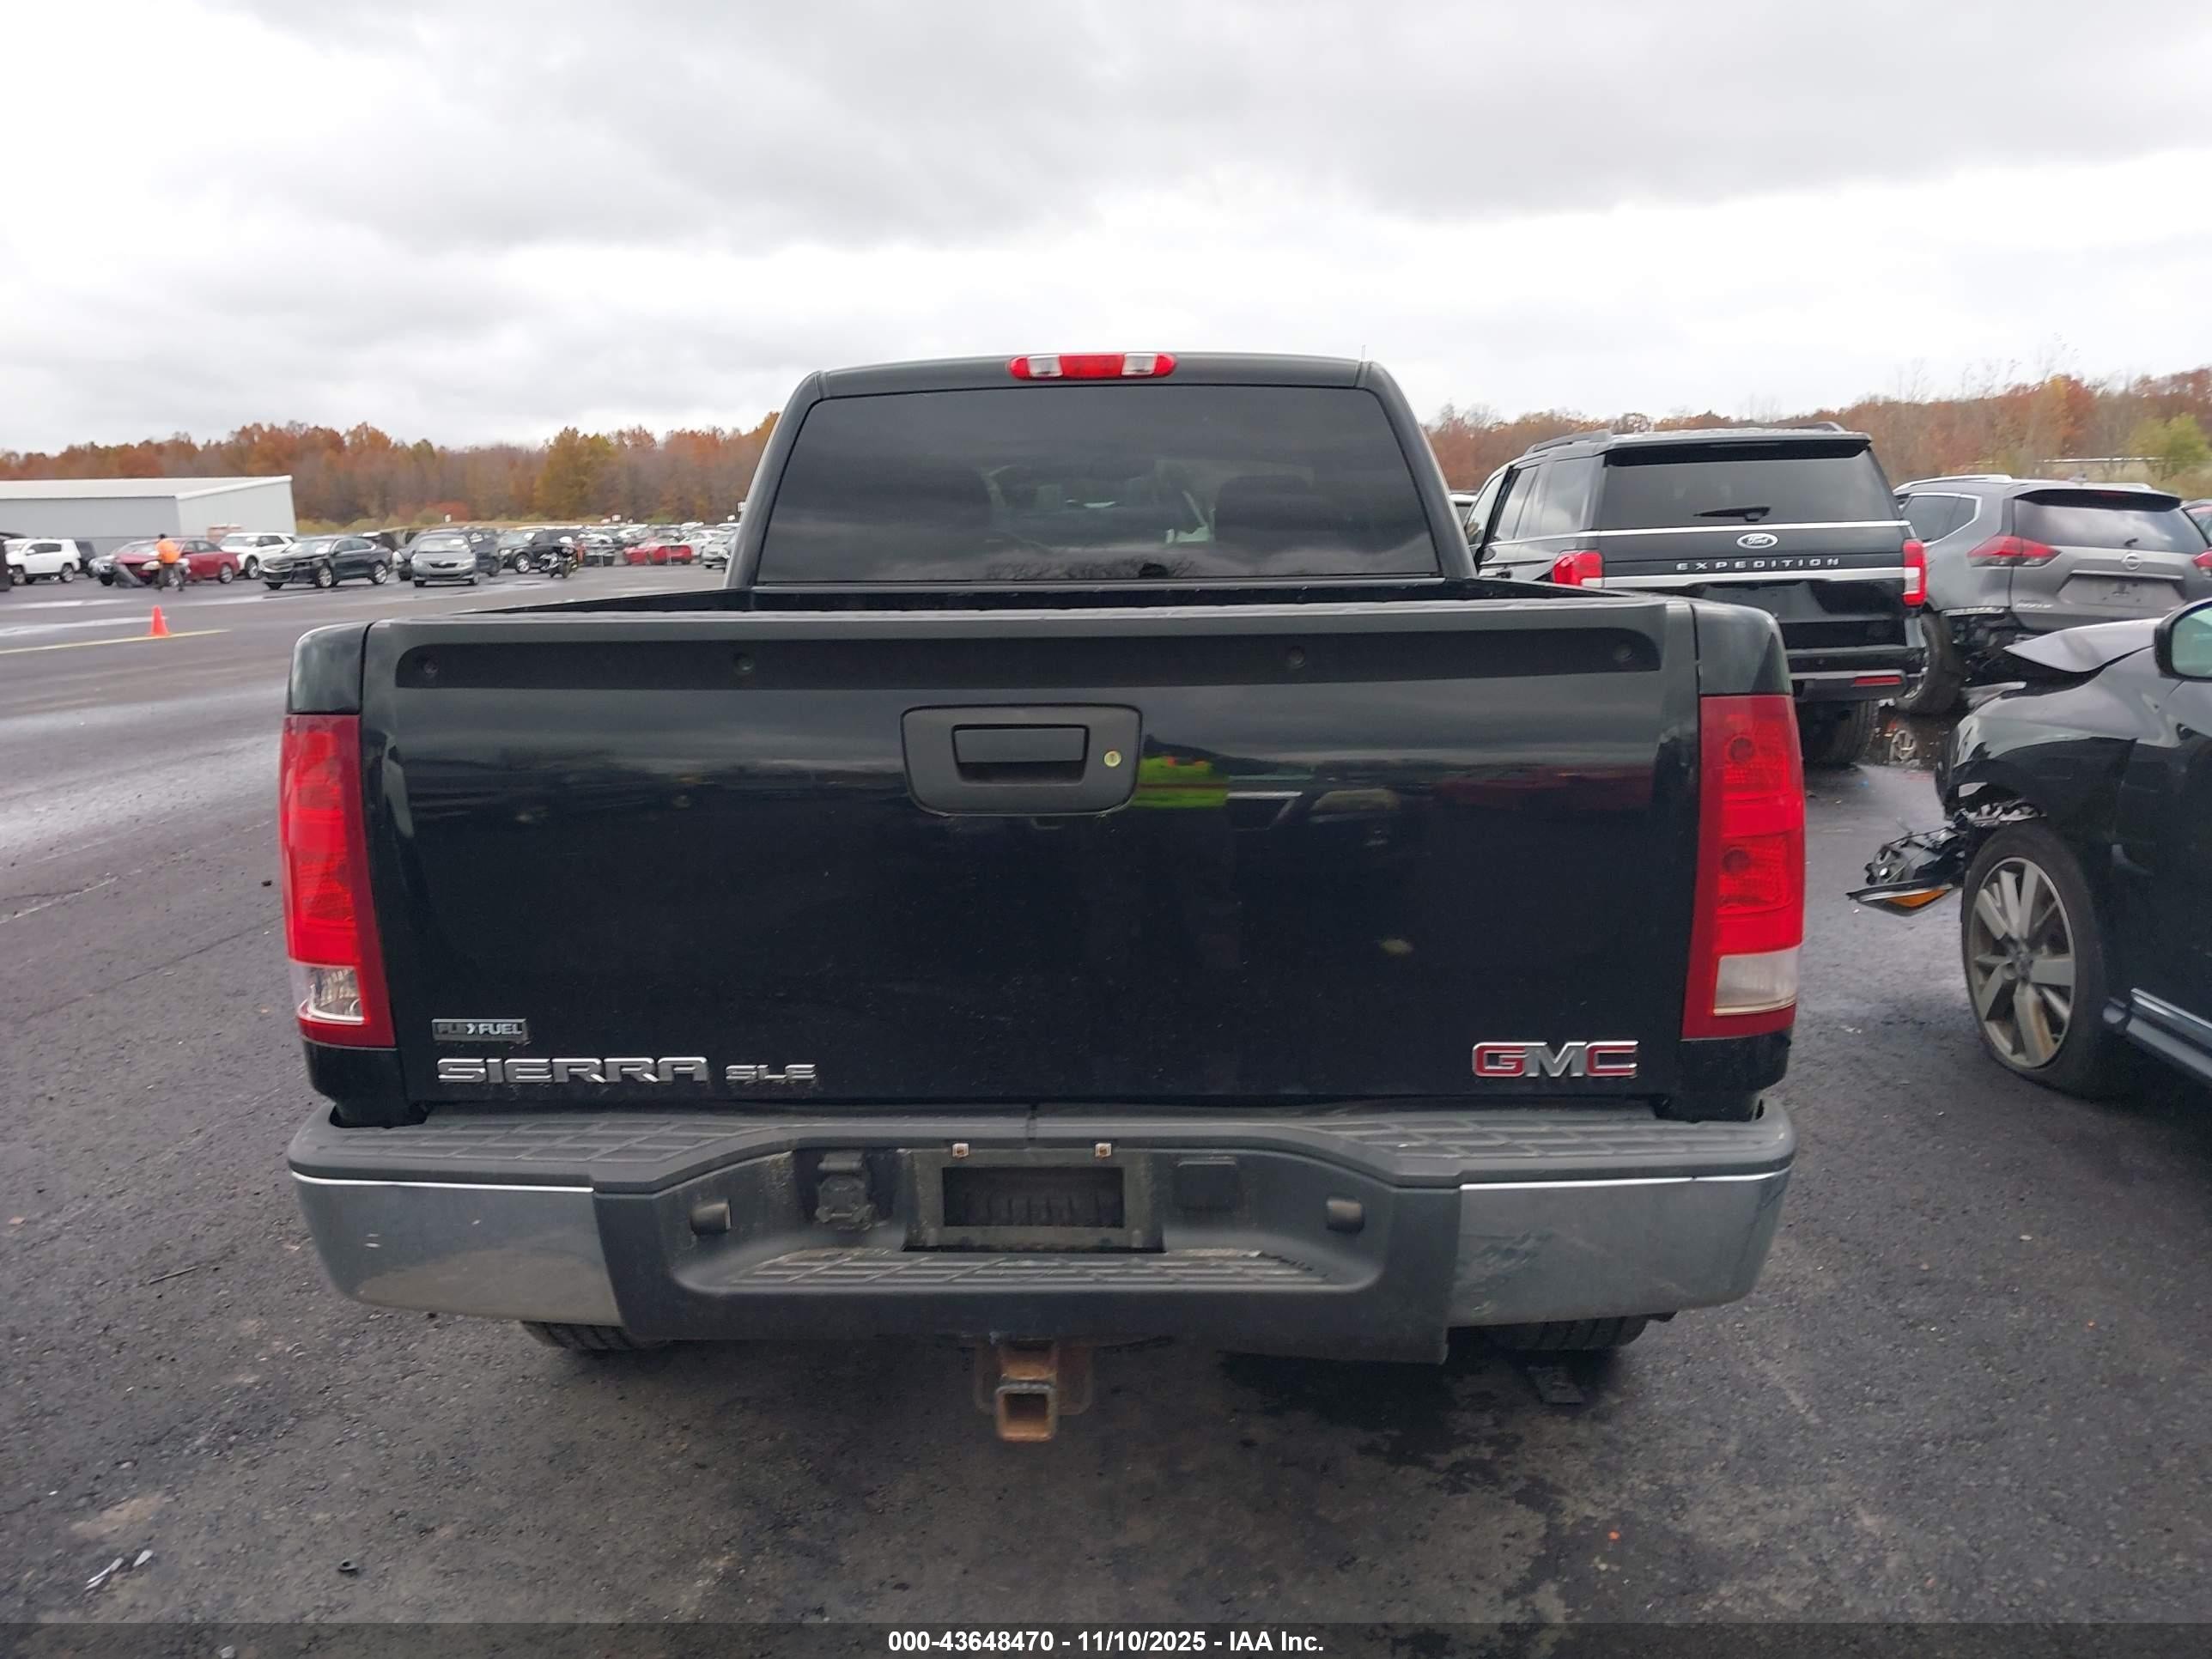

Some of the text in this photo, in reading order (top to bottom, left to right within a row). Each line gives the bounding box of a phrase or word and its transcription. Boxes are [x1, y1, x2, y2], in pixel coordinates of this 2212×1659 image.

[1675, 557, 1840, 571] EXPEDITION
[438, 1057, 817, 1083] SIERRA SLE
[1472, 1041, 1639, 1078] GMC
